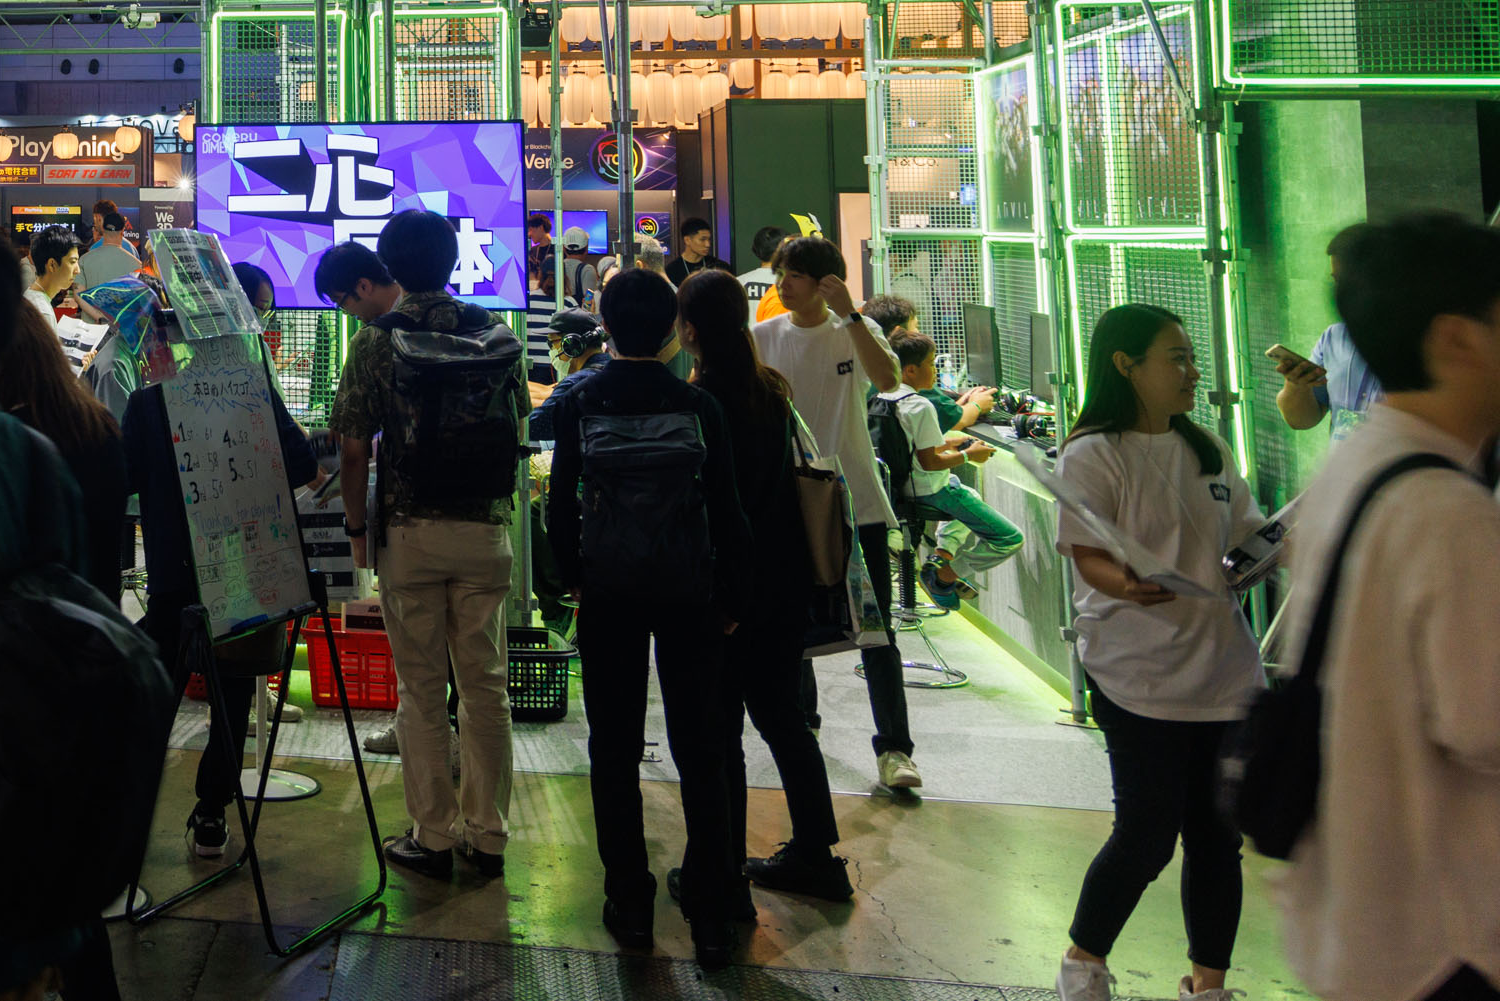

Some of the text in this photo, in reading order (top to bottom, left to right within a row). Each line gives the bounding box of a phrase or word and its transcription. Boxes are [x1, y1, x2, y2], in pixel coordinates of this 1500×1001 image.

[47, 168, 133, 179] SORT TO EARN
[227, 133, 395, 216] 二心
[156, 212, 174, 223] We
[193, 380, 250, 398] 本日のハイスコア
